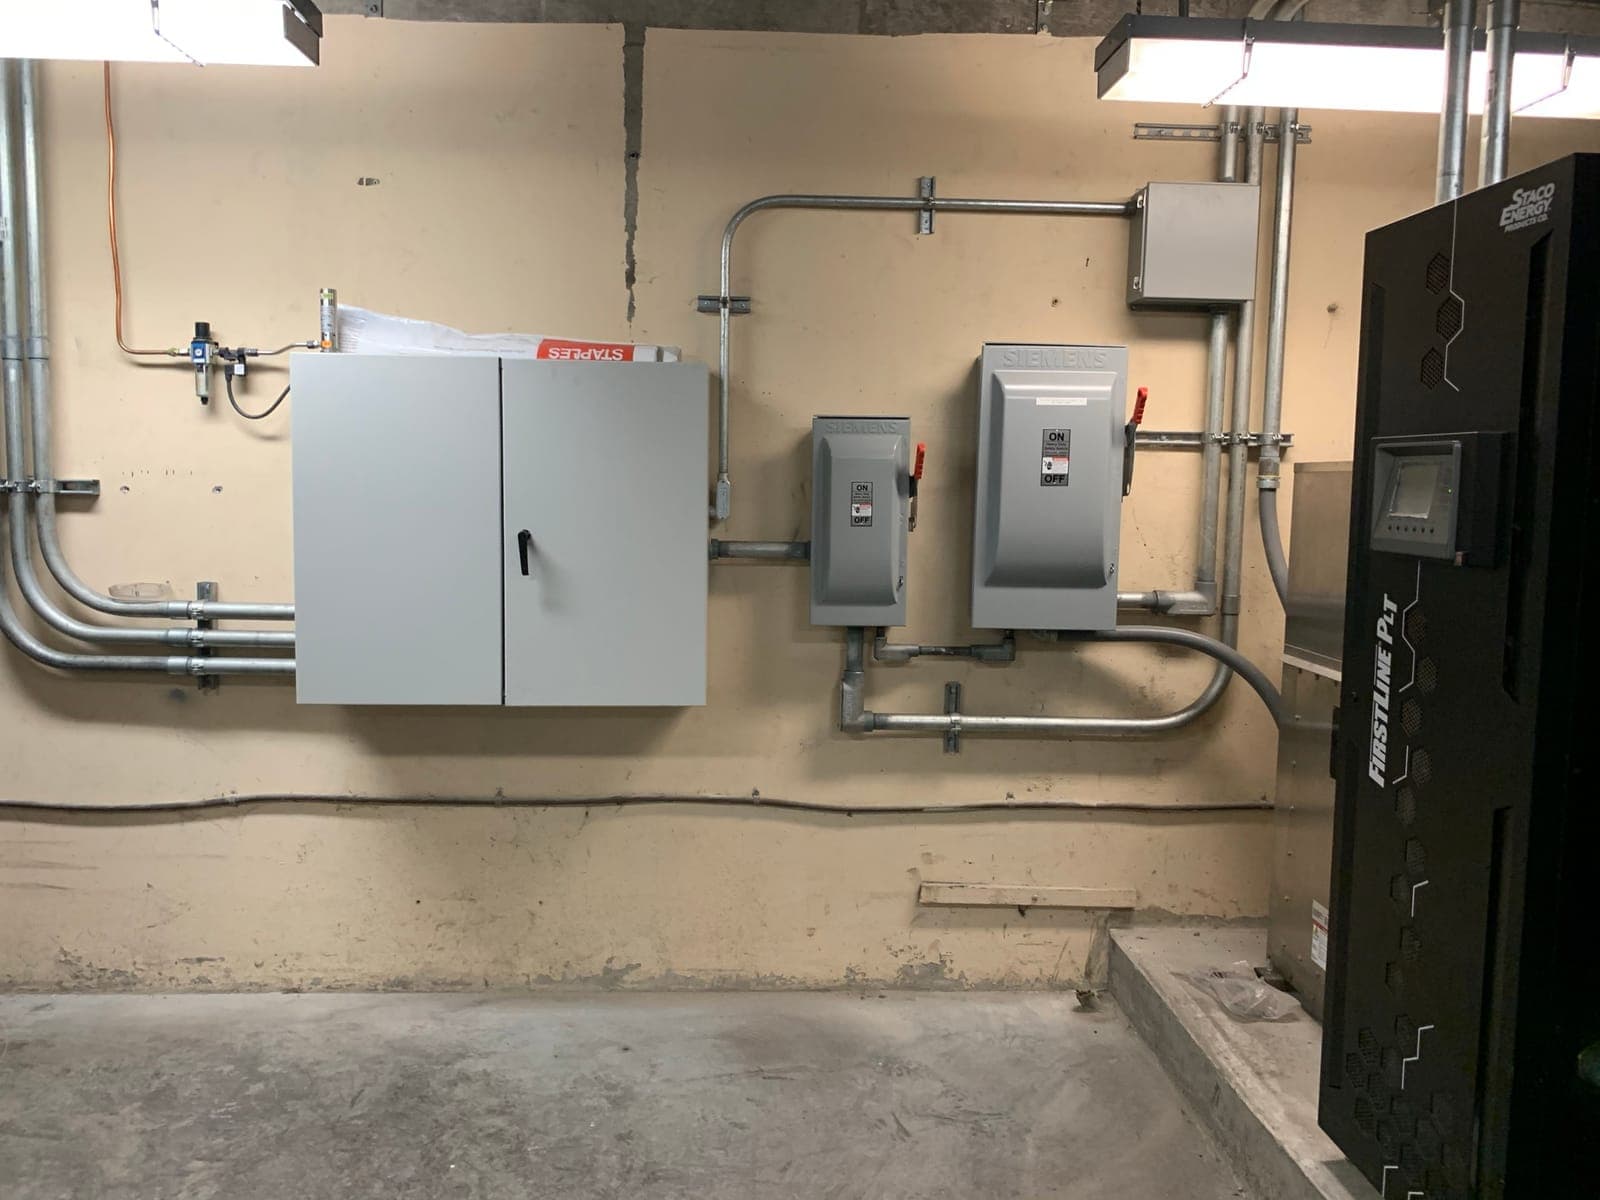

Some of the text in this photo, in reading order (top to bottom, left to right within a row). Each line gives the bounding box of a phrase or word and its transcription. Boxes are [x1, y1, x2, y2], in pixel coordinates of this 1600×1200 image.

[1510, 182, 1555, 208] STACO
[1499, 197, 1553, 226] ENERGY
[548, 346, 624, 361] STAPLES
[1002, 349, 1106, 369] SIEMENS
[1049, 432, 1065, 442] ON
[1044, 473, 1066, 484] OFF
[854, 516, 871, 524] OFF
[1368, 640, 1393, 788] FIRSTLINE
